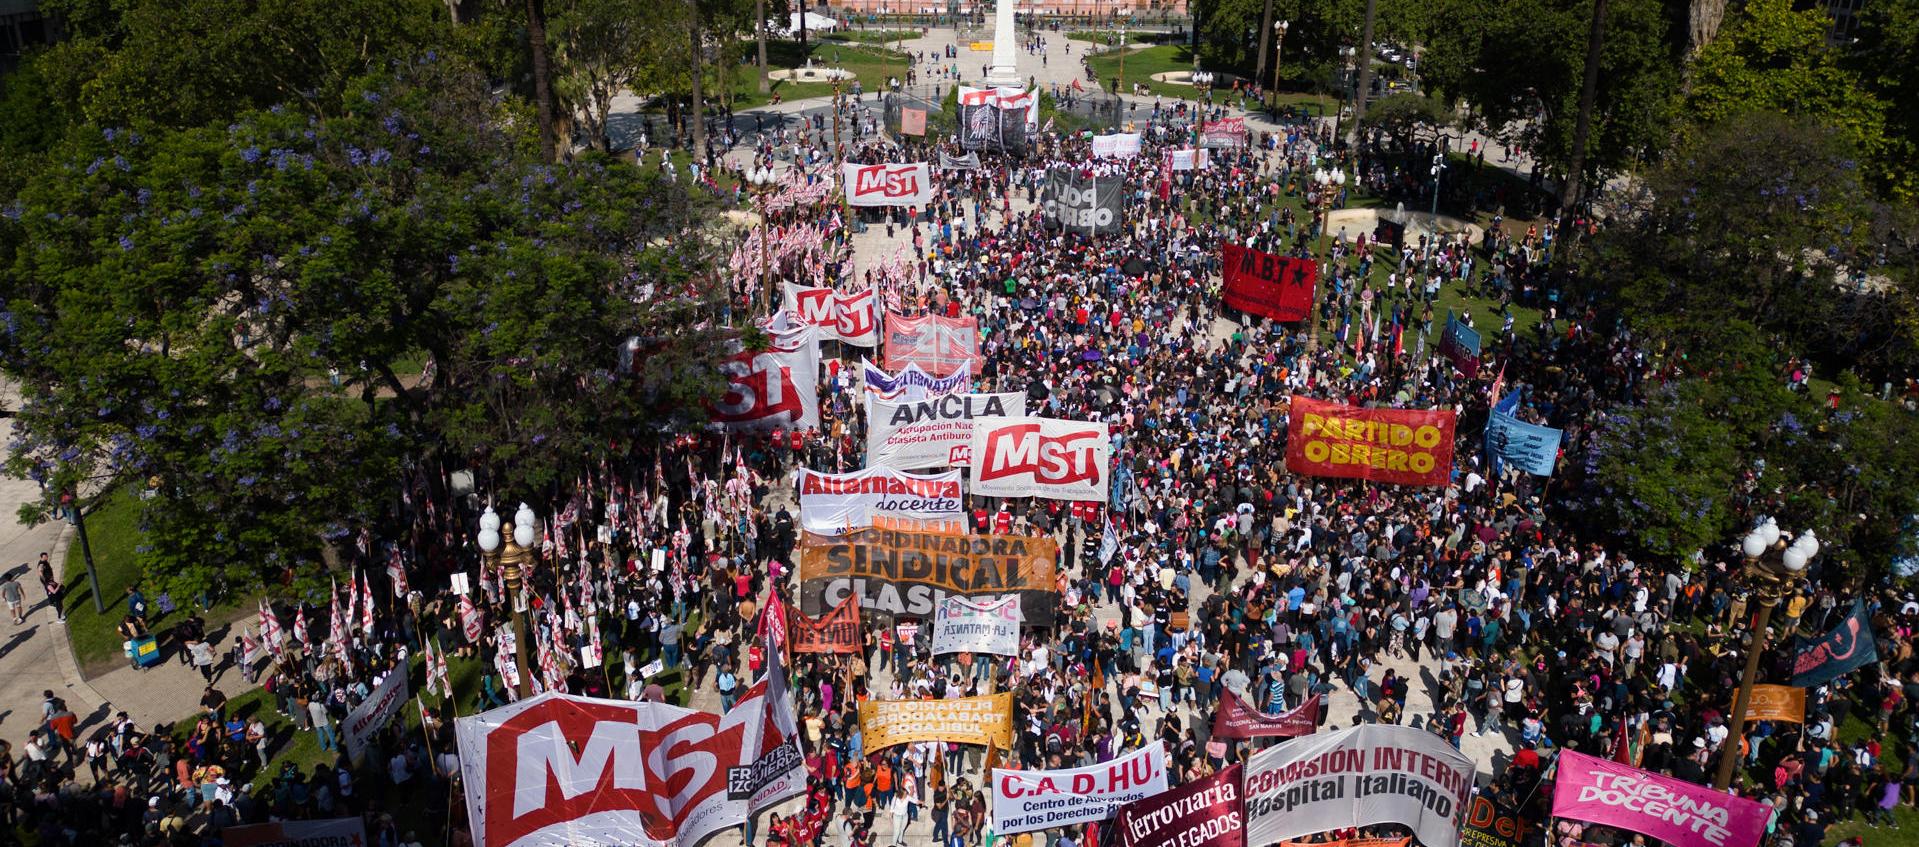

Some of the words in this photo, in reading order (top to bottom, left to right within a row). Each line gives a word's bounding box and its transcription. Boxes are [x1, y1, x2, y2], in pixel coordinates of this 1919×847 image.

[860, 169, 918, 195] MST
[803, 293, 873, 334] MST
[890, 393, 1006, 425] ANCLA
[887, 436, 927, 445] Clasista
[1302, 412, 1441, 448] PARTIDO
[991, 431, 1098, 480] MST
[1304, 439, 1435, 474] OBRERO
[802, 472, 960, 498] Alternativa
[876, 494, 959, 511] docente
[826, 545, 1028, 589] SINDICAL
[512, 694, 768, 822] MST
[1244, 744, 1366, 800] COMISIÓN
[1373, 746, 1469, 801] INTERN
[748, 780, 785, 810] UNIDAD
[1023, 799, 1066, 812] Centro
[1068, 797, 1083, 807] de
[1125, 780, 1238, 844] ferroviaria
[1246, 775, 1345, 822] Hospital
[1355, 773, 1452, 818] Italiano
[1588, 770, 1729, 827] TRIBUNA
[1002, 819, 1022, 831] por
[1026, 815, 1044, 826] los
[1047, 806, 1104, 823] Derechos
[1157, 810, 1241, 847] ELEGADOS
[1577, 786, 1732, 847] DOCENTE
